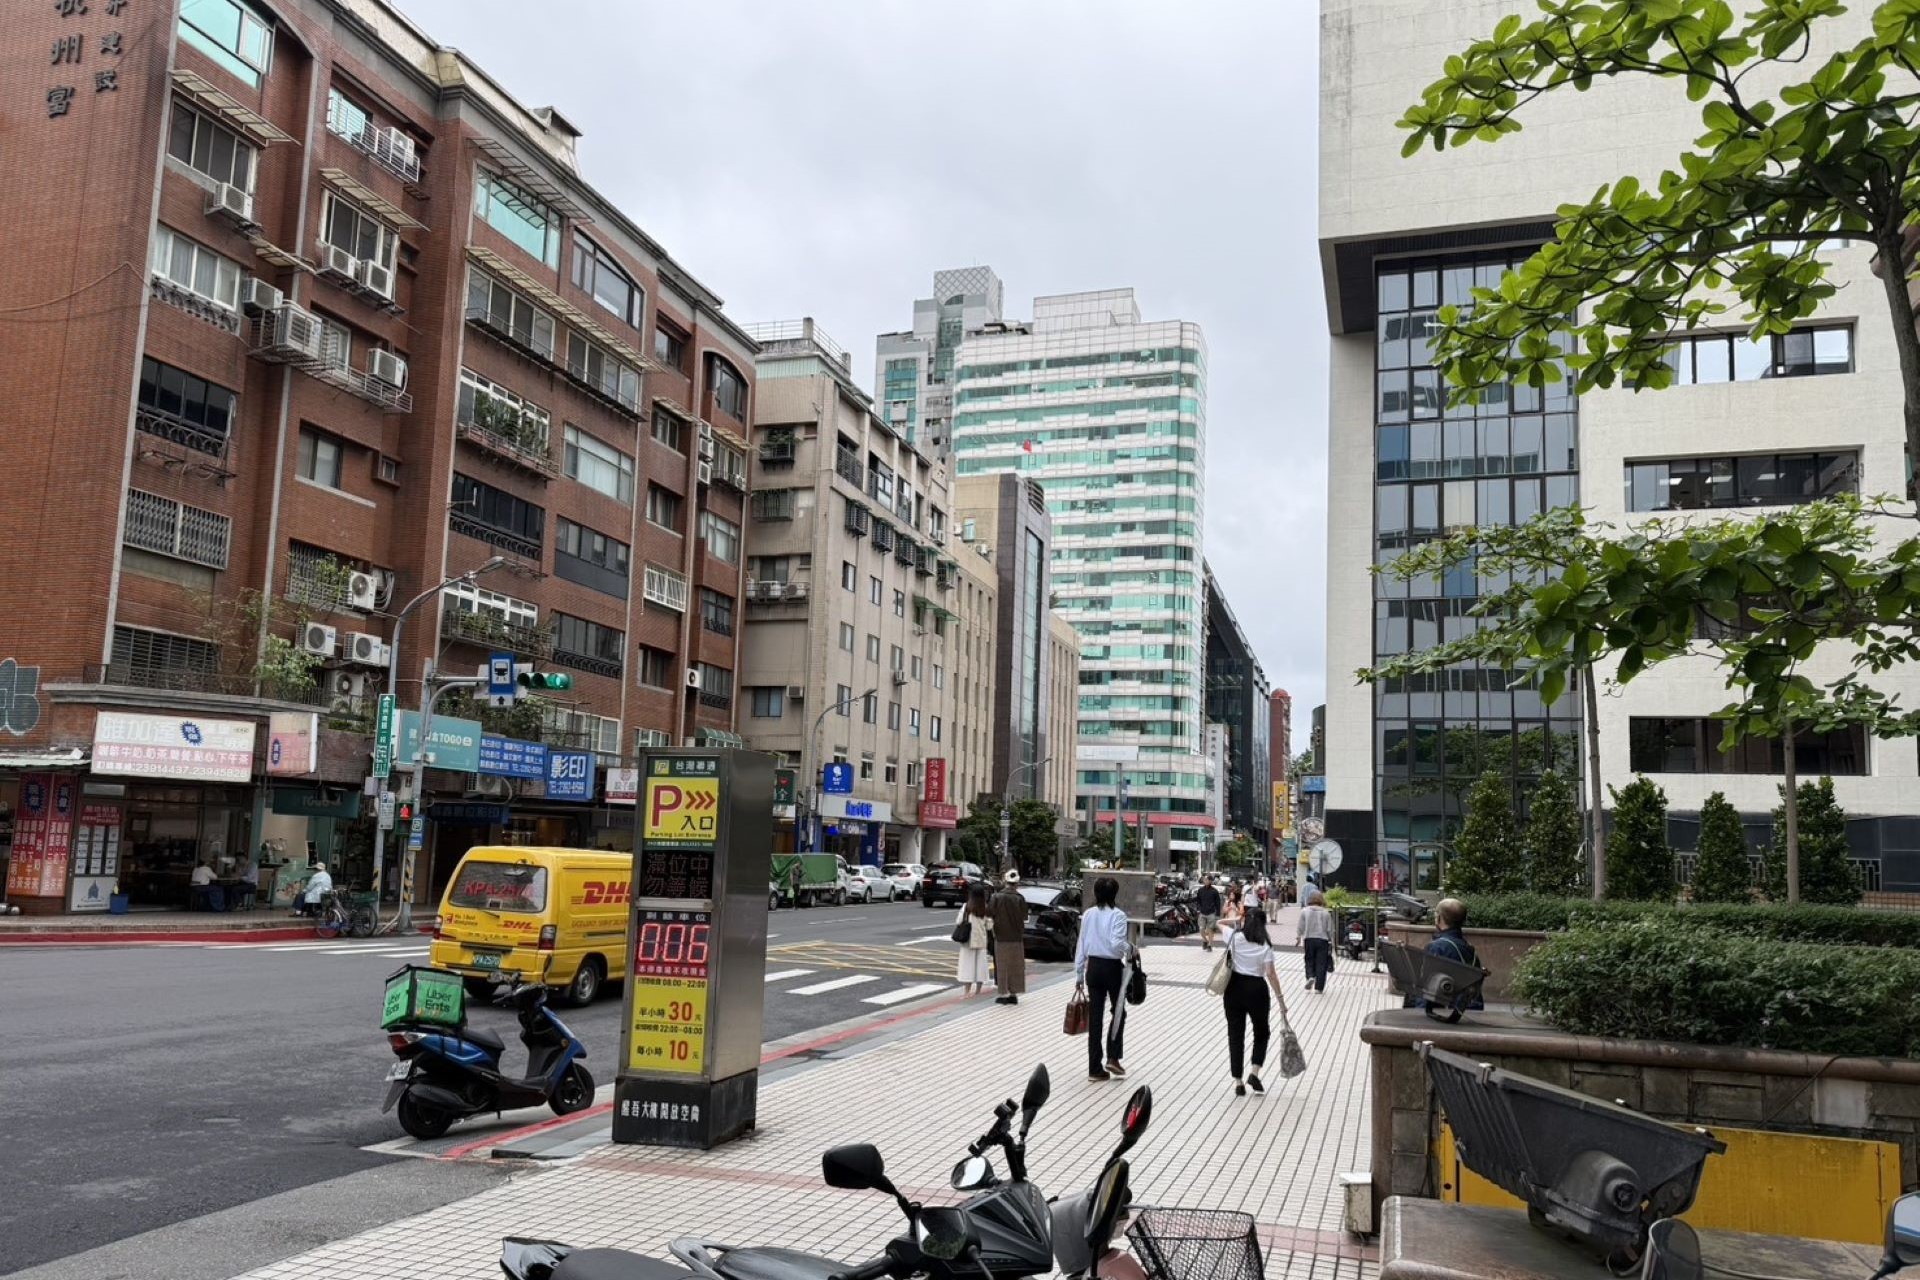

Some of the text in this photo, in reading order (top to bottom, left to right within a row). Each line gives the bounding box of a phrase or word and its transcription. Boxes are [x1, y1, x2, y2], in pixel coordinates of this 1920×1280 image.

[551, 755, 587, 779] 影印
[651, 784, 683, 827] P
[681, 815, 714, 831] 入口
[503, 920, 534, 930] DHL
[638, 923, 711, 964] 006
[425, 998, 451, 1012] Eats
[427, 987, 452, 1002] Uber
[668, 1001, 693, 1022] 30
[669, 1040, 688, 1061] 10
